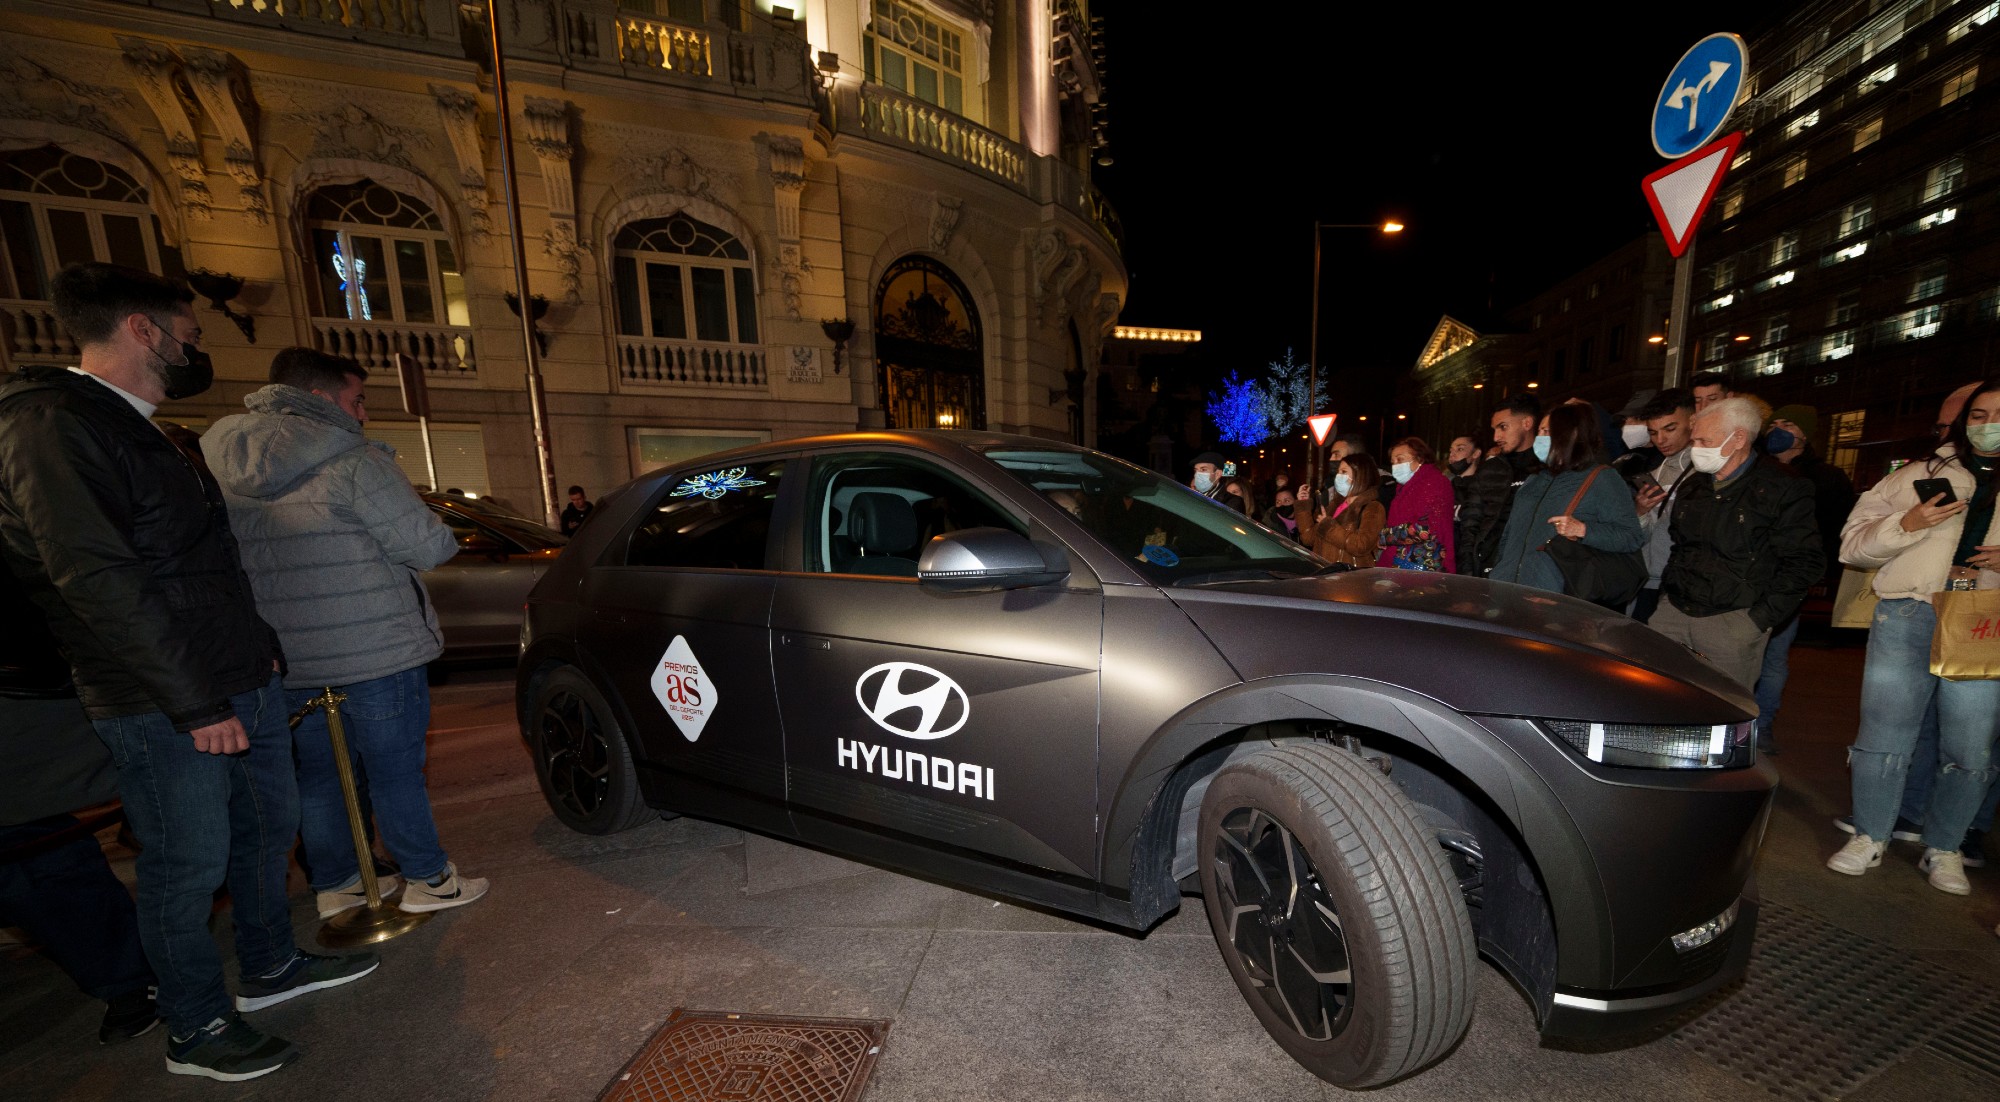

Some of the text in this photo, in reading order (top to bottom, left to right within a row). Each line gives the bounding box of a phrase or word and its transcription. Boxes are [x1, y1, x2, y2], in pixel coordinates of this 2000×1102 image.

[664, 662, 698, 674] PREMIOS
[667, 674, 701, 706] as
[680, 707, 704, 716] DEPORTE
[838, 738, 994, 800] HYUNDAI
[687, 1033, 830, 1069] AYUNTAMIENTO DE
